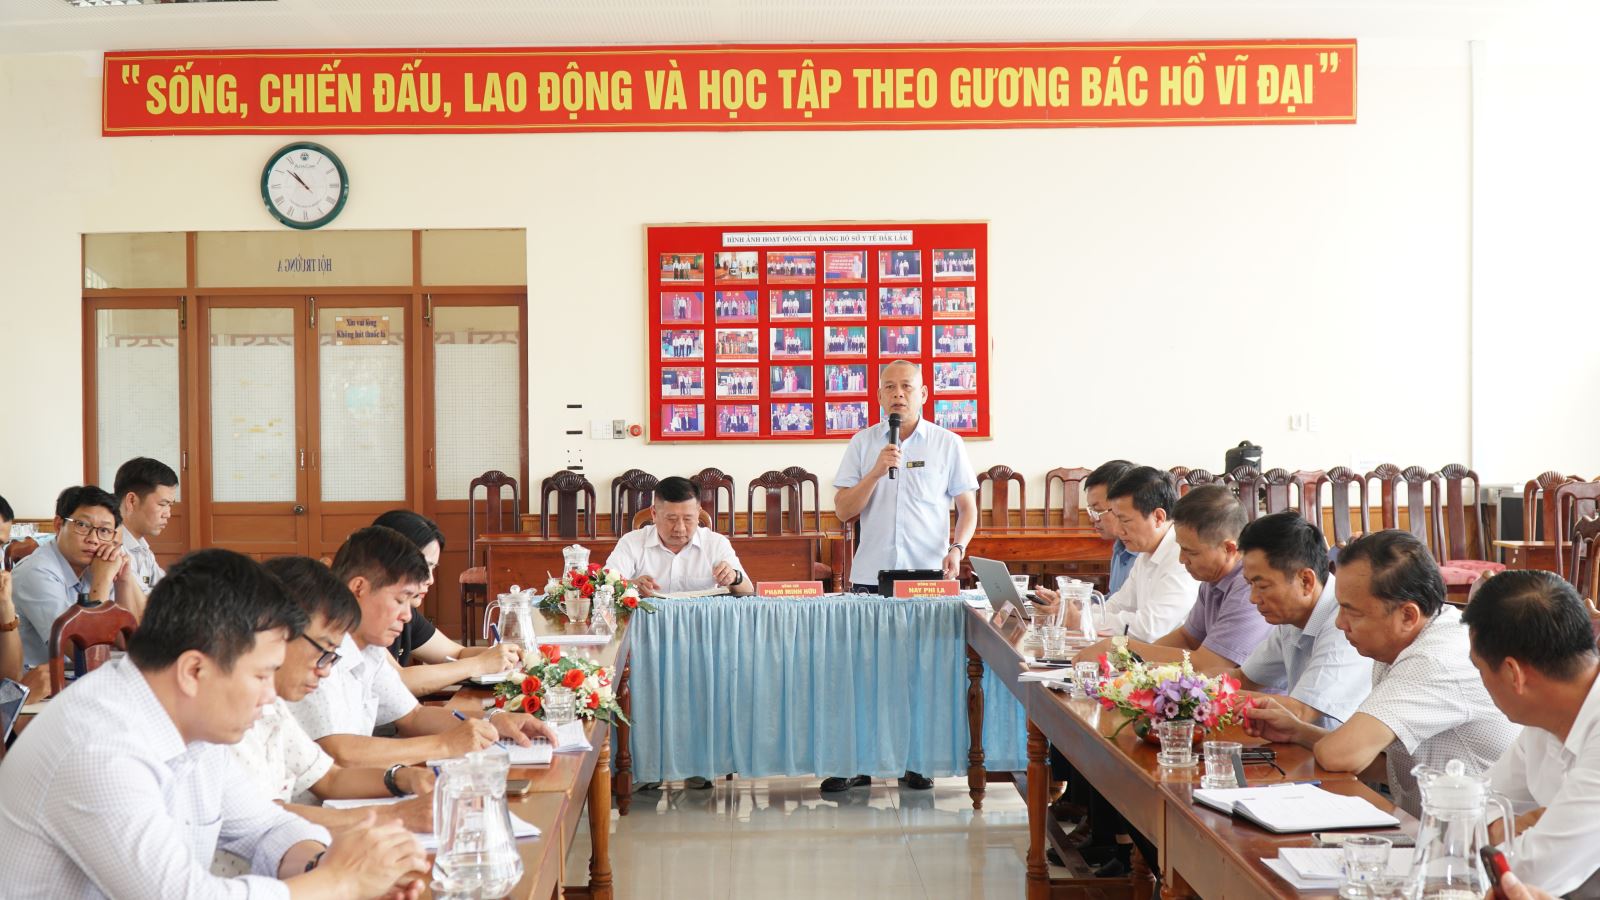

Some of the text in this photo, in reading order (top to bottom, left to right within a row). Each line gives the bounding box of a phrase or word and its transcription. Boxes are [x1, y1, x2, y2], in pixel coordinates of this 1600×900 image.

[259, 59, 362, 114] CHIẾN
[372, 60, 452, 118] ĐẤU,
[464, 71, 527, 113] LAO
[537, 60, 633, 120] ĐỘNG
[644, 59, 688, 111] VÀ
[699, 68, 768, 119] HỌC
[777, 58, 842, 119] TẬP
[852, 67, 938, 110] THEO
[949, 65, 1071, 109] GƯƠNG
[1080, 55, 1150, 109] BÁC
[1159, 51, 1207, 107] HỒ
[1214, 53, 1250, 107] VĨ
[726, 235, 745, 243] HÌNH
[745, 233, 761, 243] ẢNH
[762, 234, 780, 244] HOẠT
[782, 233, 802, 244] ĐỘNG
[803, 232, 818, 242] CỦA
[819, 232, 839, 242] ĐẢNG
[840, 233, 850, 243] BỘ
[851, 232, 861, 241] SỞ
[868, 232, 878, 241] TẾ
[346, 318, 356, 326] Xin
[336, 330, 354, 339] Không
[354, 330, 364, 338] hút
[364, 329, 379, 338] thuốc
